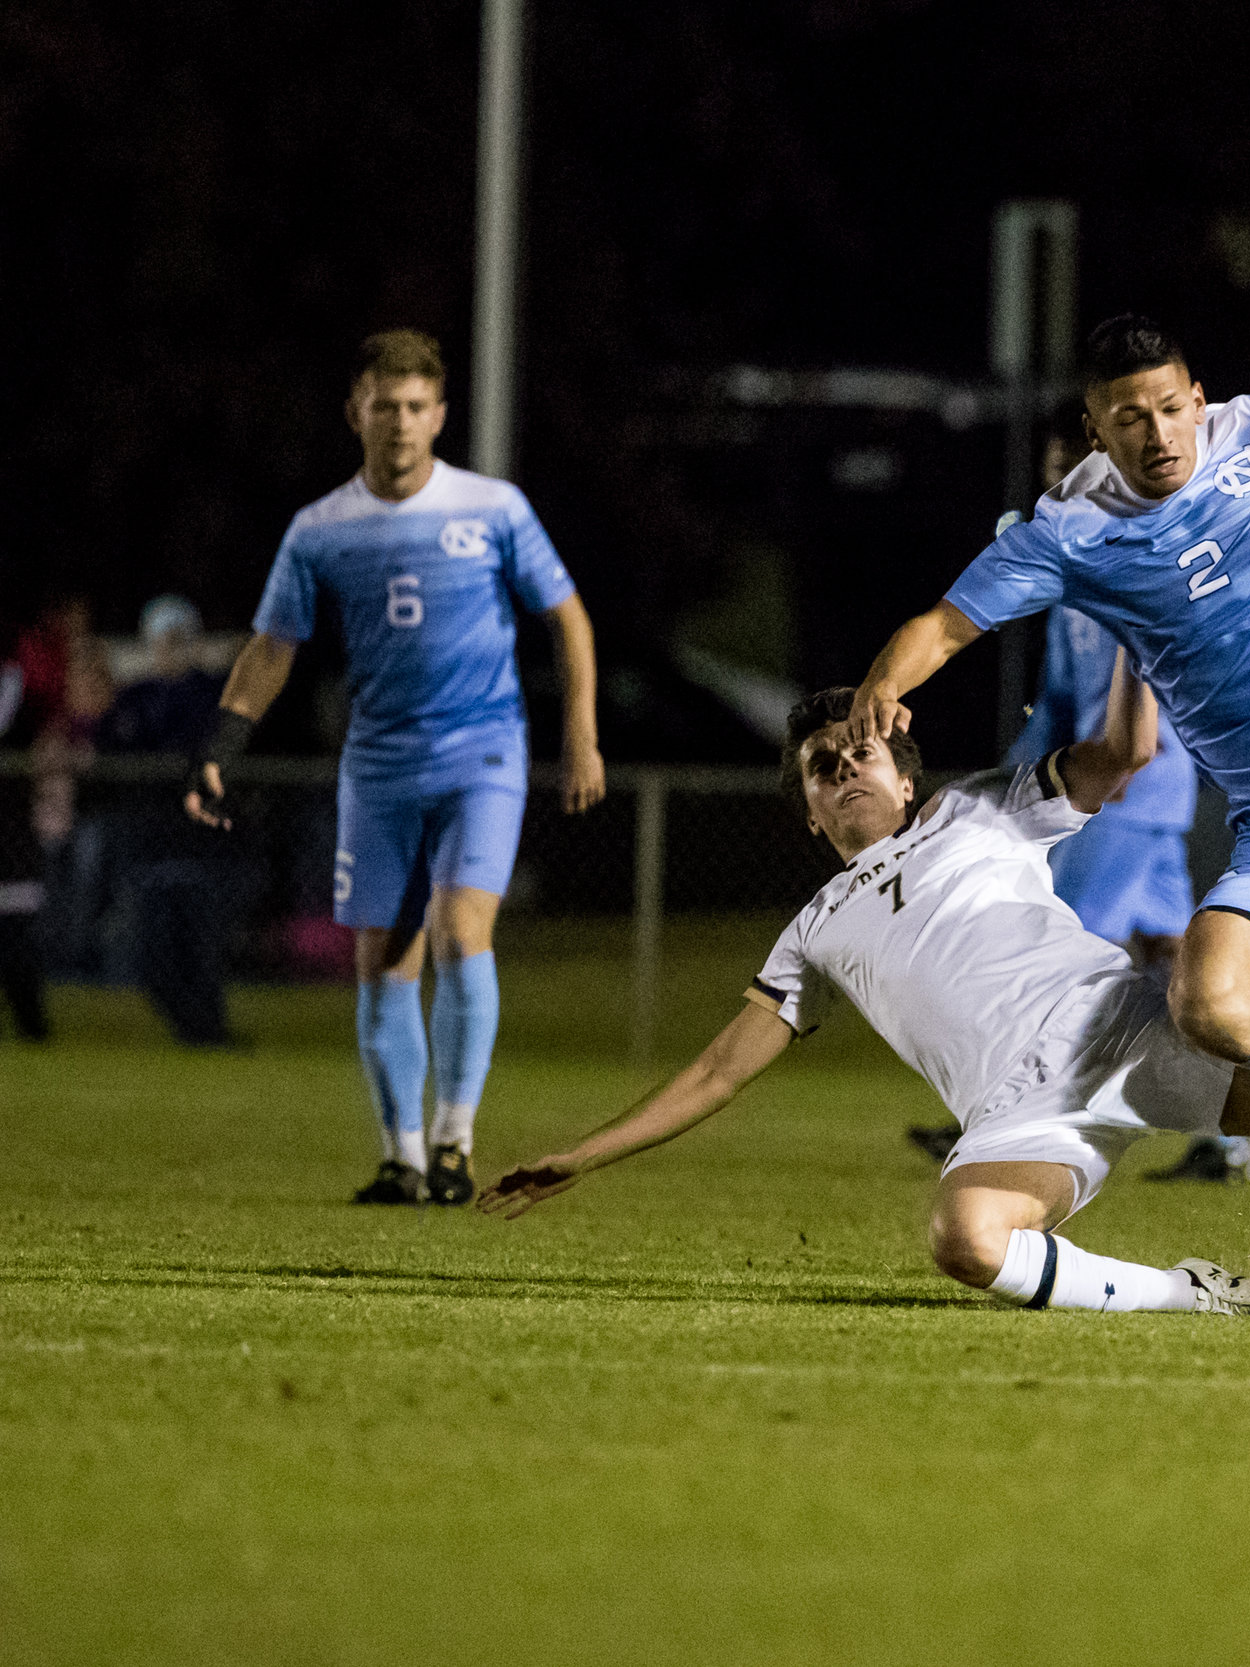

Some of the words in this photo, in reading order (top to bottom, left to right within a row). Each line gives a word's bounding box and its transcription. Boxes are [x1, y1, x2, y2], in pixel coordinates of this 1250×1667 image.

[1177, 538, 1230, 602] 2
[385, 574, 423, 628] 6
[878, 871, 906, 914] 7
